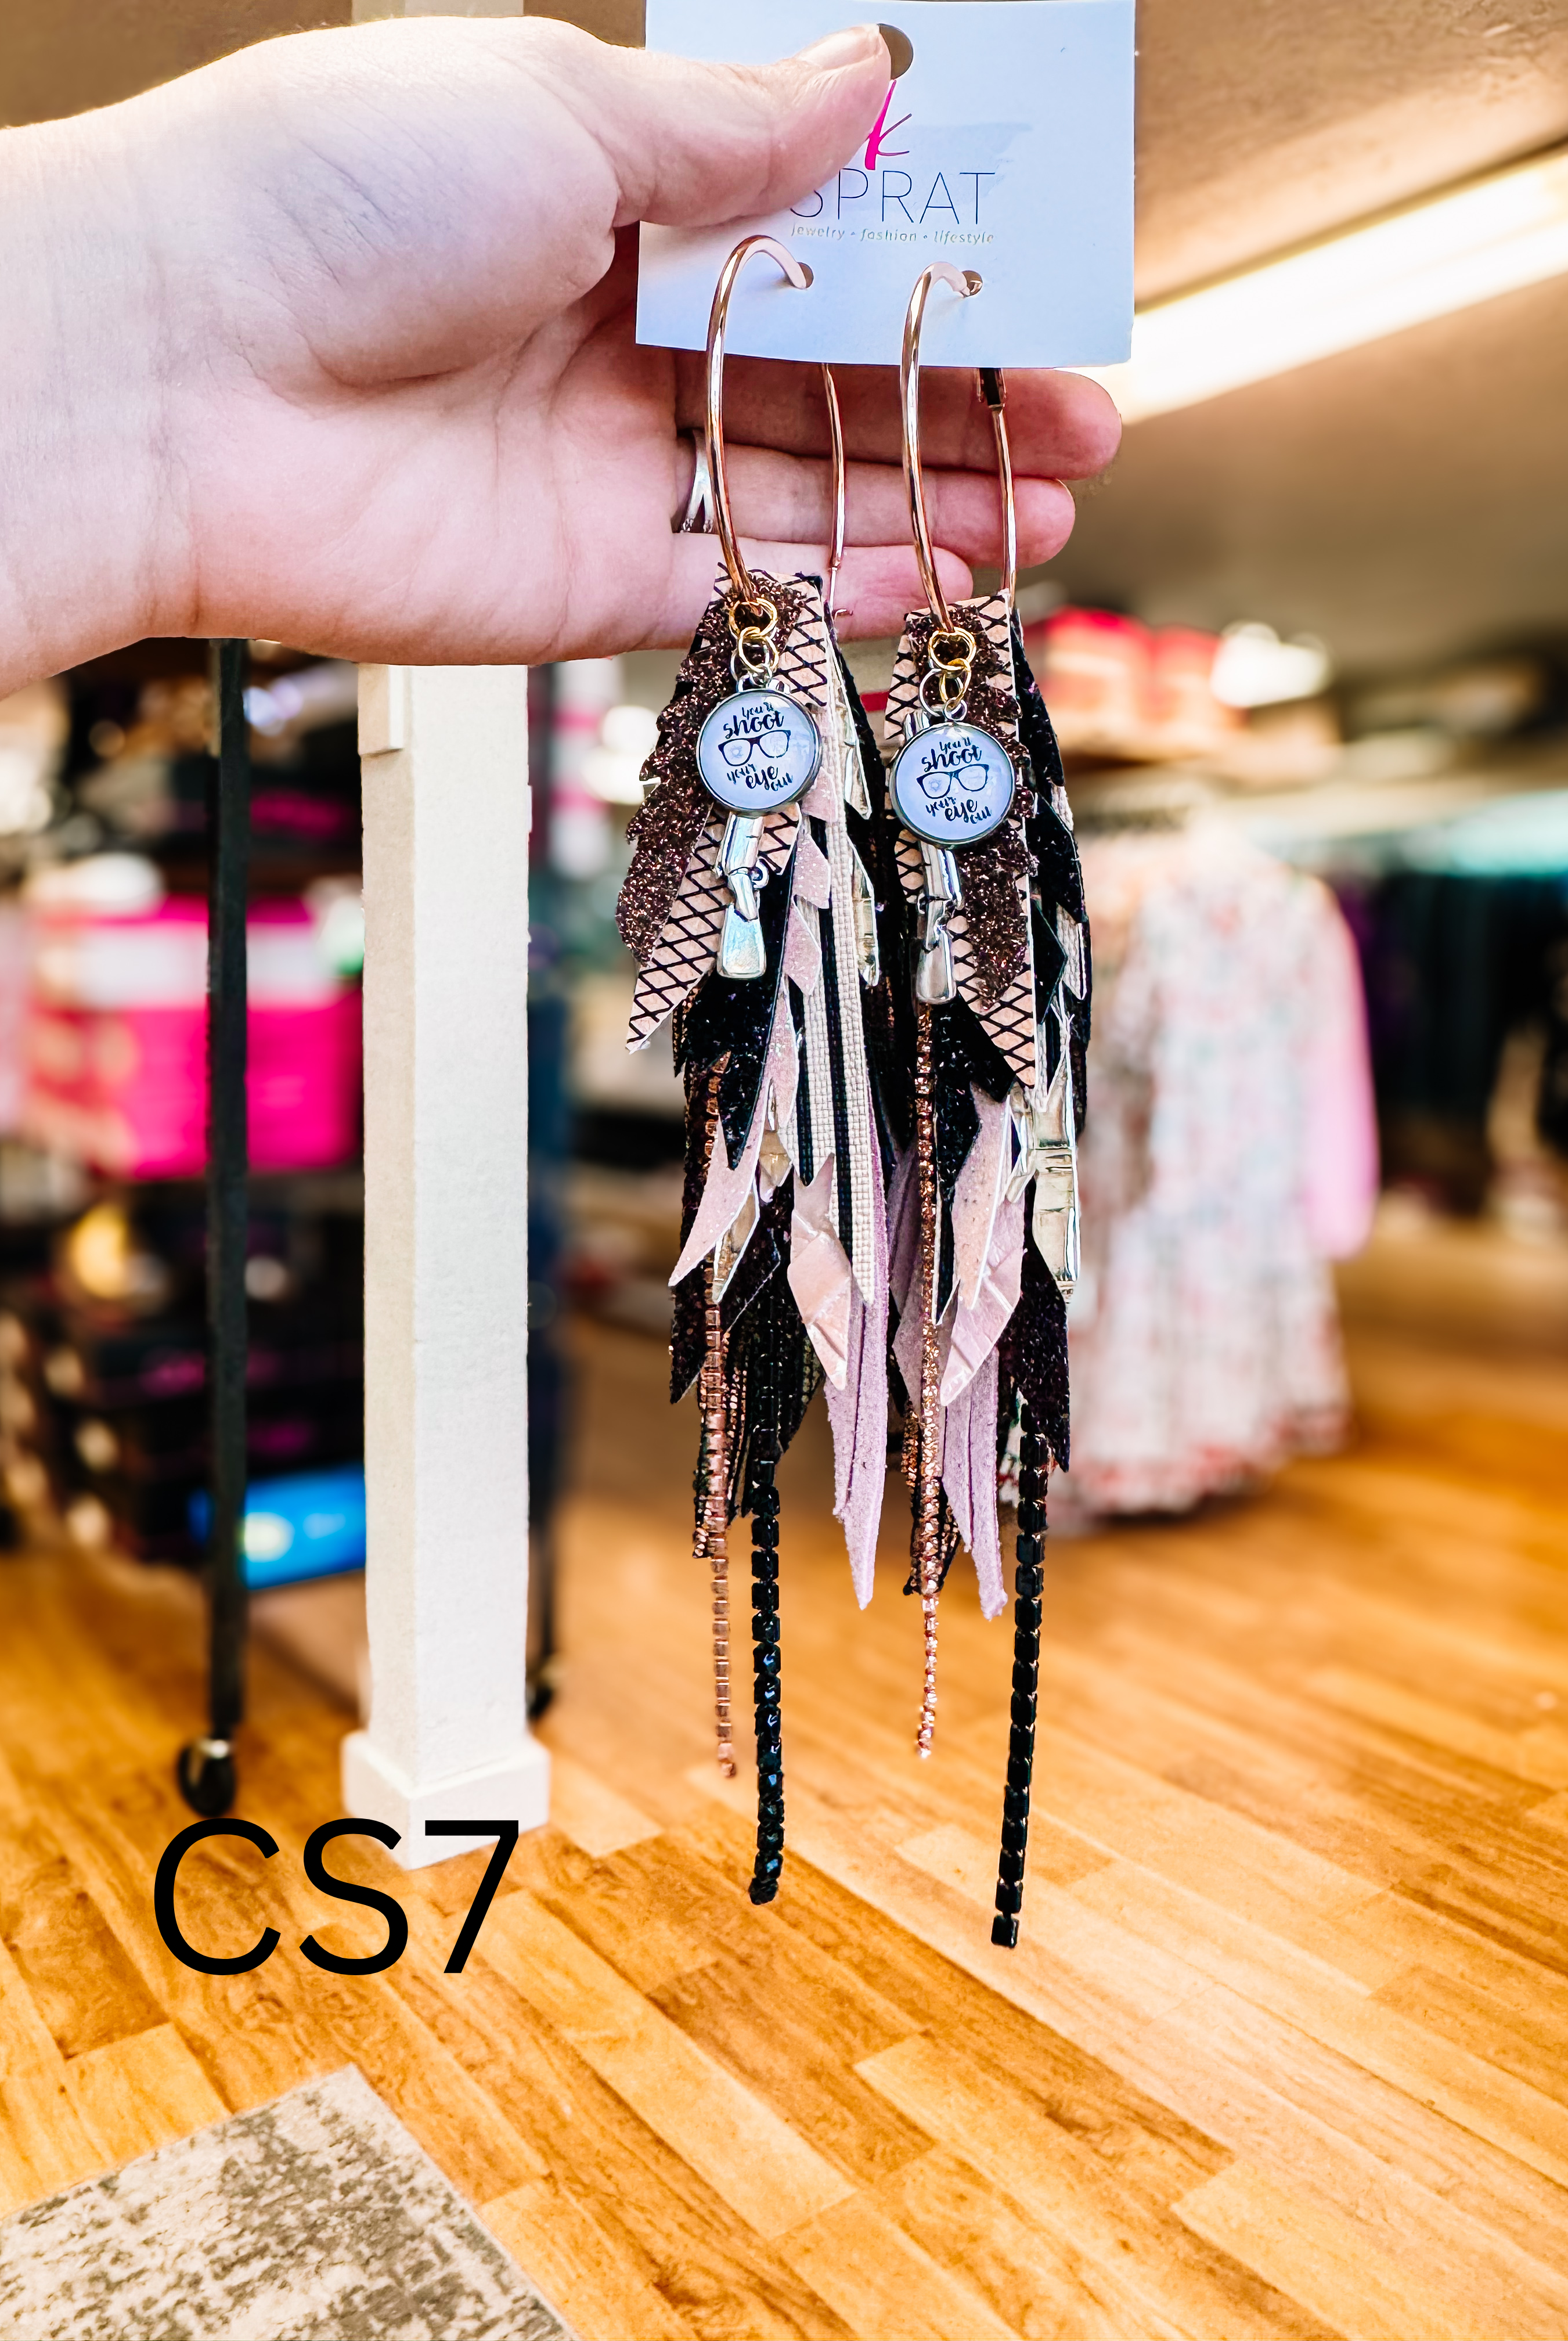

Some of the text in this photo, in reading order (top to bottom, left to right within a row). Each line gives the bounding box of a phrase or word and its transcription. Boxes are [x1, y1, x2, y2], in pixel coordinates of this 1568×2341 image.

[791, 222, 994, 246] jewelry fashion lifestyle
[723, 710, 784, 740] shoot
[921, 744, 982, 773] shoot
[726, 763, 757, 784] your
[745, 765, 778, 791] eye
[925, 796, 957, 817] your
[945, 798, 978, 823] eye
